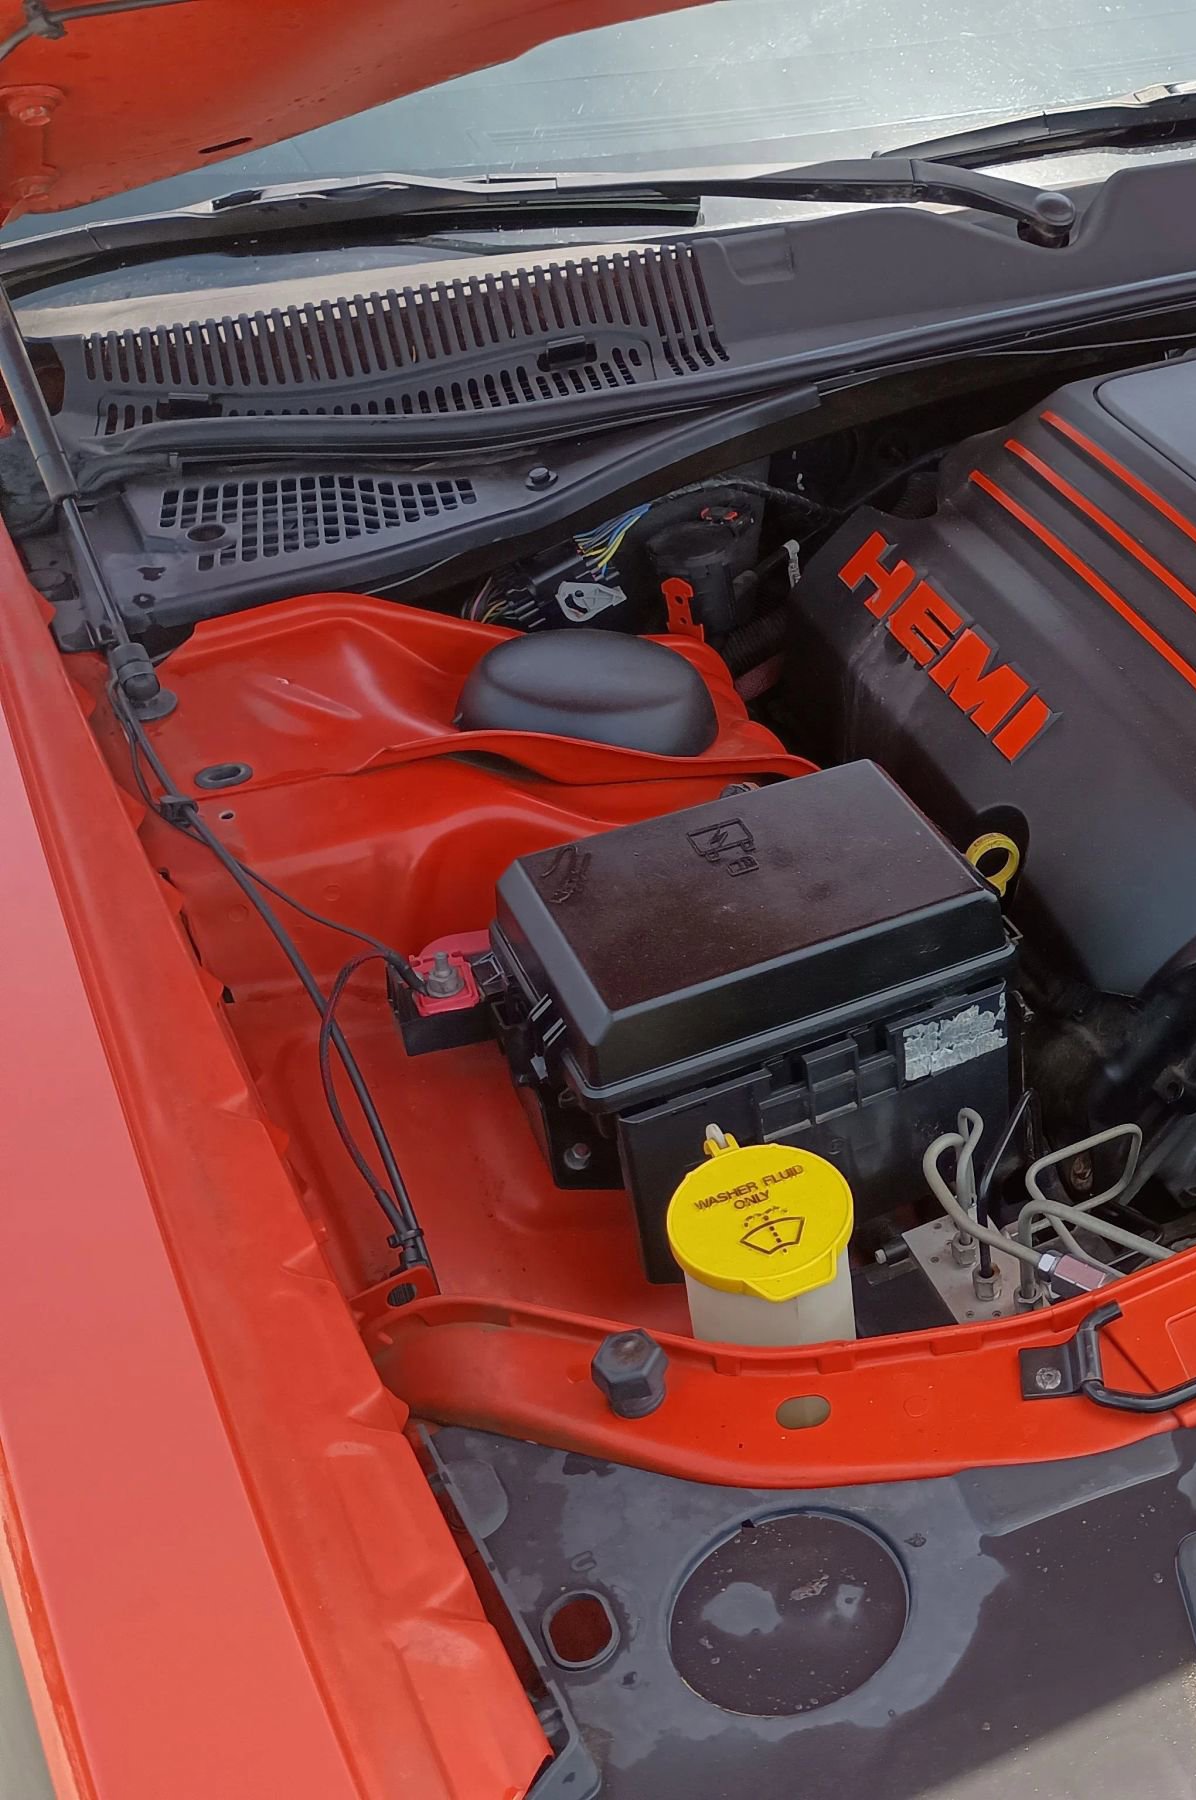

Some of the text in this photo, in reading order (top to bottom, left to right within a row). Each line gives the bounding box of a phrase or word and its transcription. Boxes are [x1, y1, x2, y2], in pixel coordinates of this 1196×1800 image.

[838, 531, 1055, 763] HEMI
[695, 1165, 804, 1211] WASHER FLUID
[734, 1189, 770, 1210] ONLY
